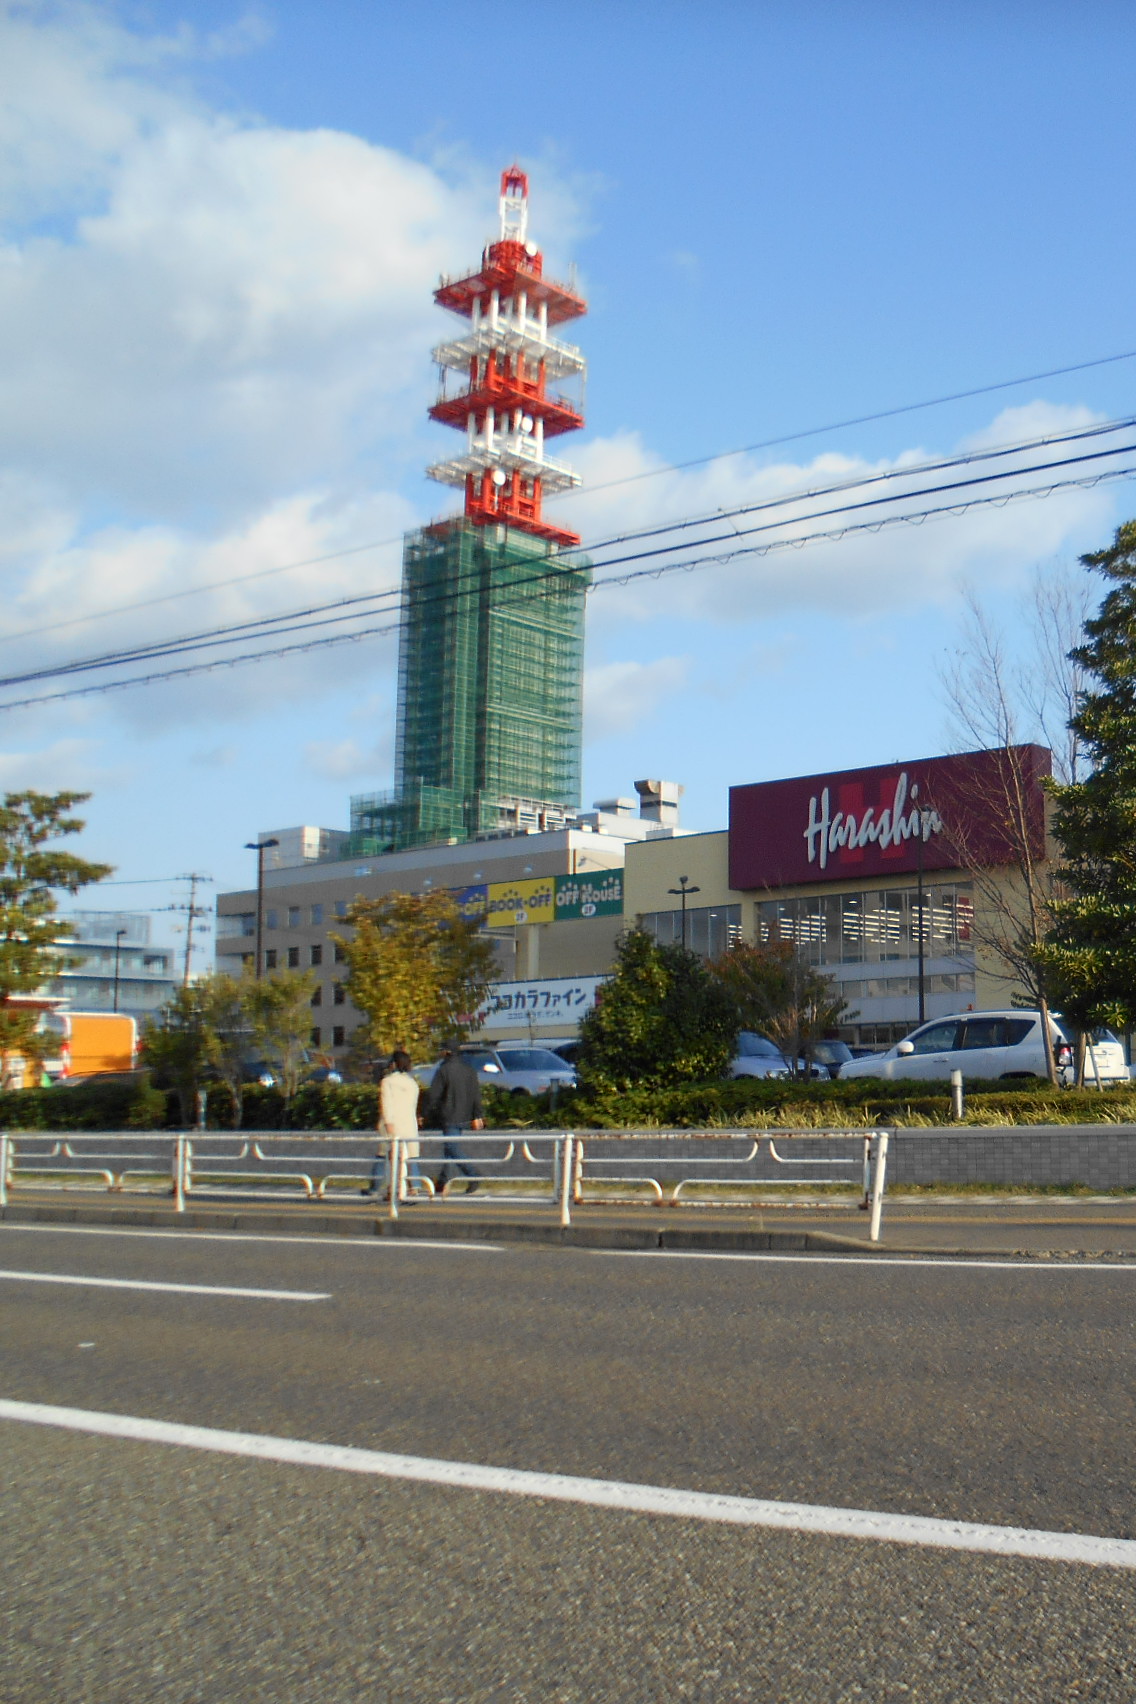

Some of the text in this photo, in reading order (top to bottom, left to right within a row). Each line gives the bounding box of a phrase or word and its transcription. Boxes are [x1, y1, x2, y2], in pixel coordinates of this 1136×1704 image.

[803, 771, 943, 869] Harashin
[556, 885, 622, 906] OFF HOUSE
